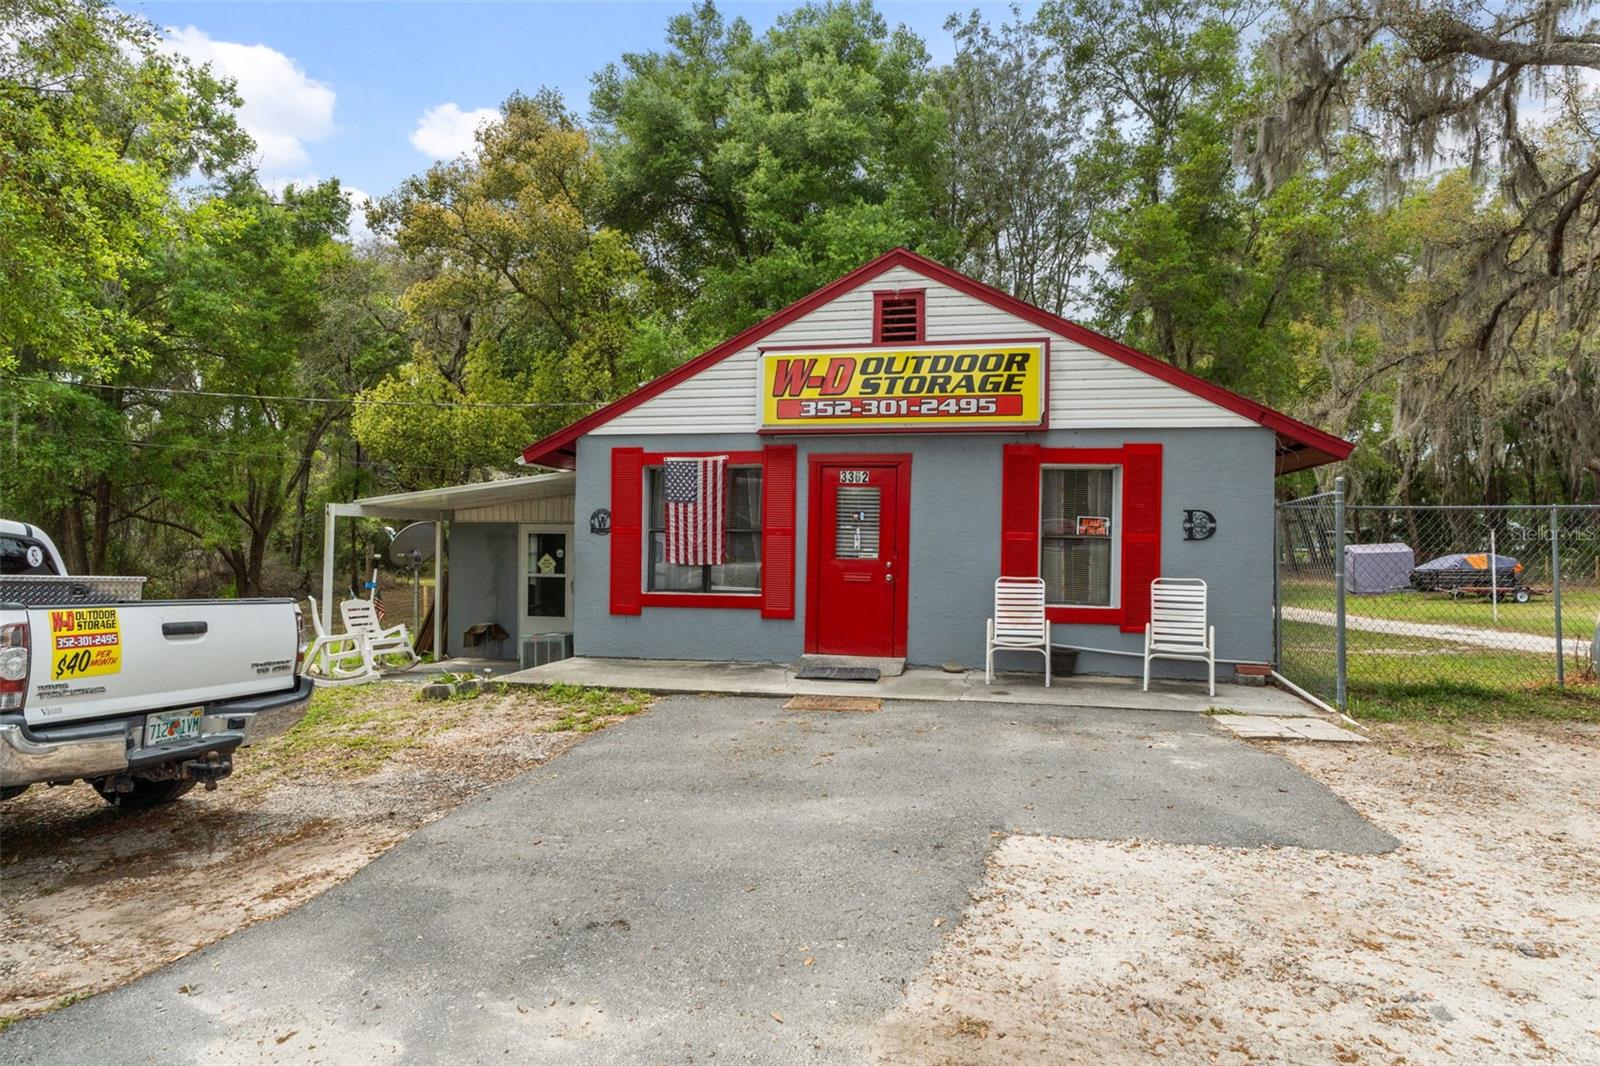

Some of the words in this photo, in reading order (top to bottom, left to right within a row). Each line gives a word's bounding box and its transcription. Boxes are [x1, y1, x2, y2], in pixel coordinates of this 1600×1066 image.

[859, 352, 1031, 375] OUTDOOR
[773, 356, 856, 398] W-D
[859, 373, 1026, 395] STORAGE
[800, 397, 997, 417] 352-301-2495
[841, 471, 868, 483] 3362
[75, 609, 116, 621] OUTDOOR
[77, 619, 117, 631] STORAGE
[57, 633, 118, 649] 352-301-2495
[95, 649, 112, 658] PER
[56, 649, 91, 680] $40
[90, 657, 118, 667] MONTH
